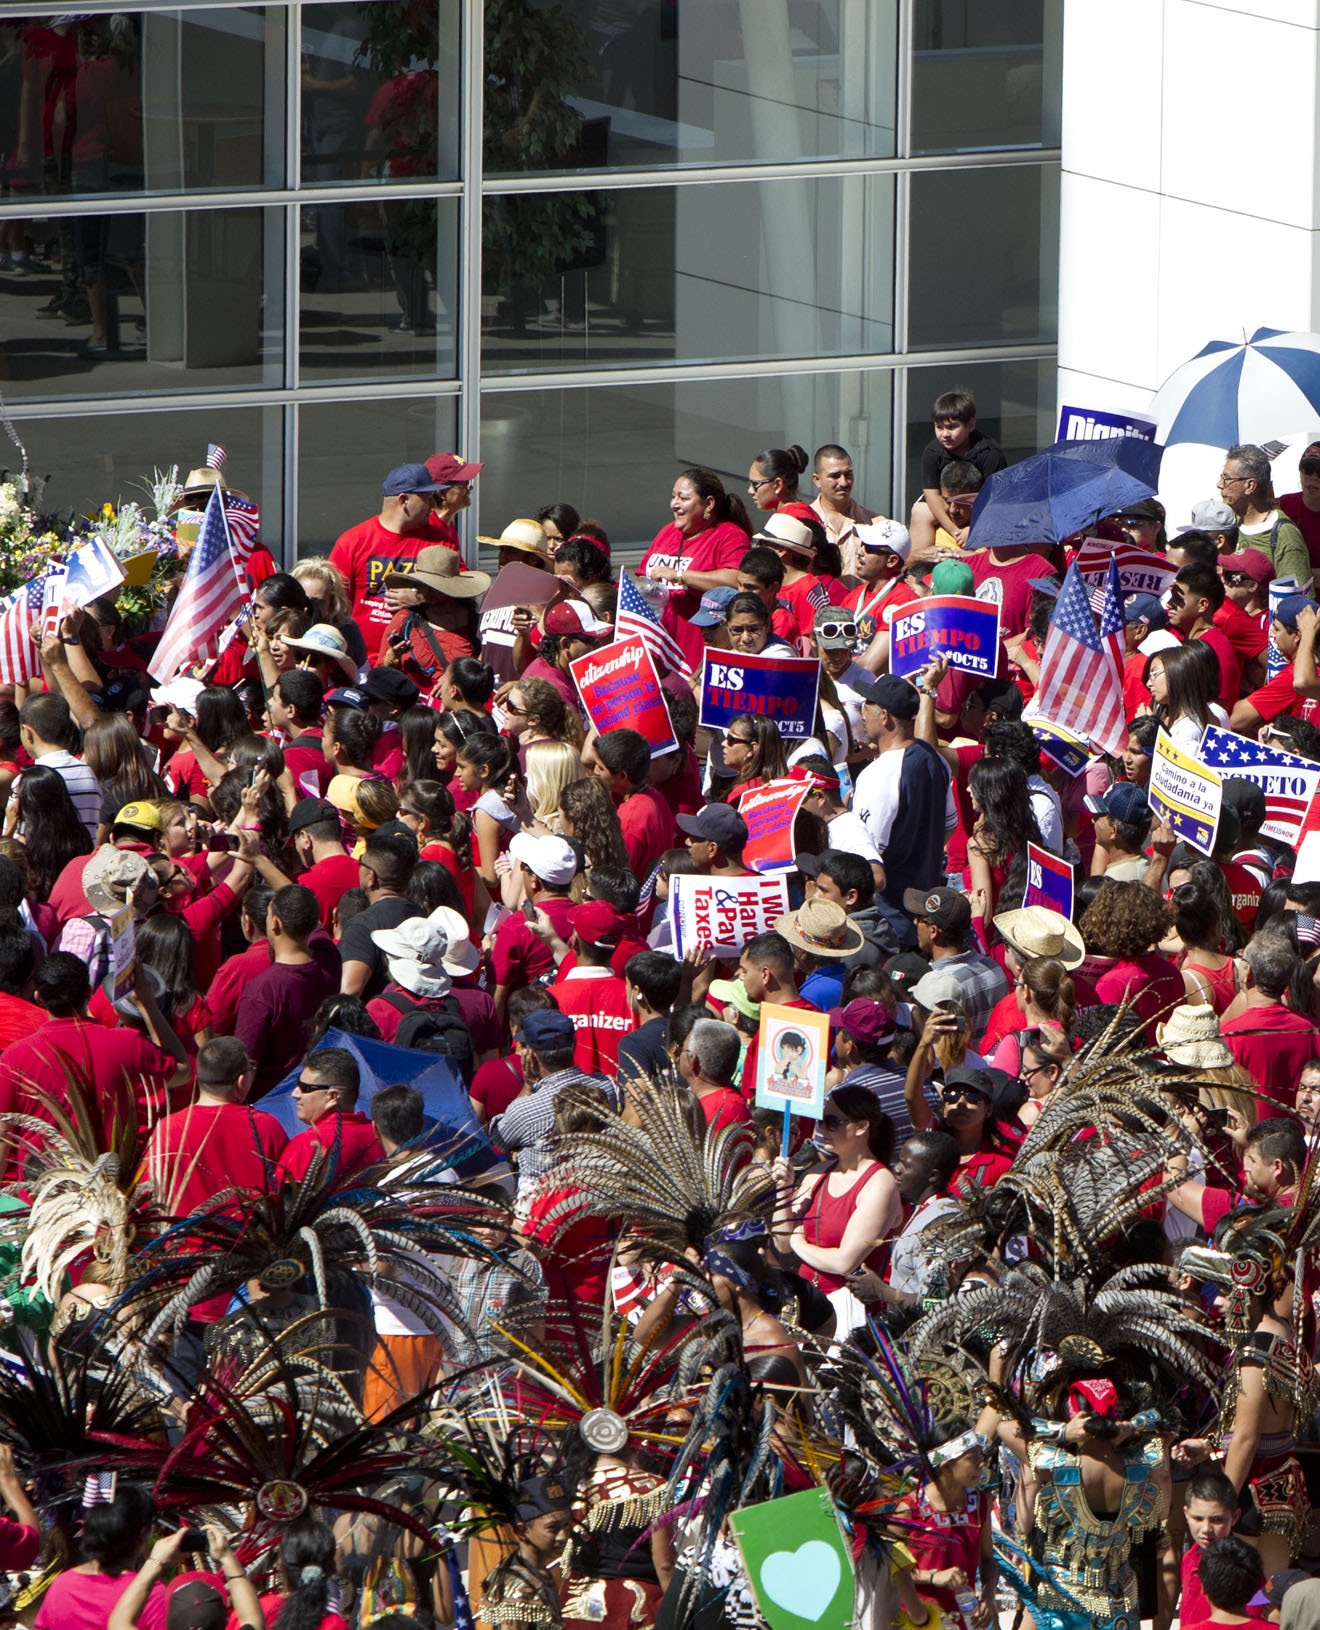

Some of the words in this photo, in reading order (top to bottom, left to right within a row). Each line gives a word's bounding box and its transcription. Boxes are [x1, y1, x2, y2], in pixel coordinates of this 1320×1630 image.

[1066, 414, 1149, 441] Dignit
[896, 611, 926, 641] ES
[895, 628, 981, 659] TIEMPO
[580, 646, 645, 690] citizenship
[945, 649, 988, 671] #OCT5
[709, 663, 744, 691] ES
[708, 686, 799, 716] TIEMPO
[776, 720, 805, 733] CT5
[1155, 772, 1201, 805] ciudadanía
[1203, 799, 1214, 811] ya
[1161, 762, 1188, 785] Camino
[1189, 779, 1196, 788] a
[1198, 782, 1207, 793] la
[1030, 859, 1043, 890] ES
[715, 889, 739, 908] &
[762, 894, 785, 933] Wo
[695, 886, 714, 951] Taxes
[715, 907, 738, 947] Pay
